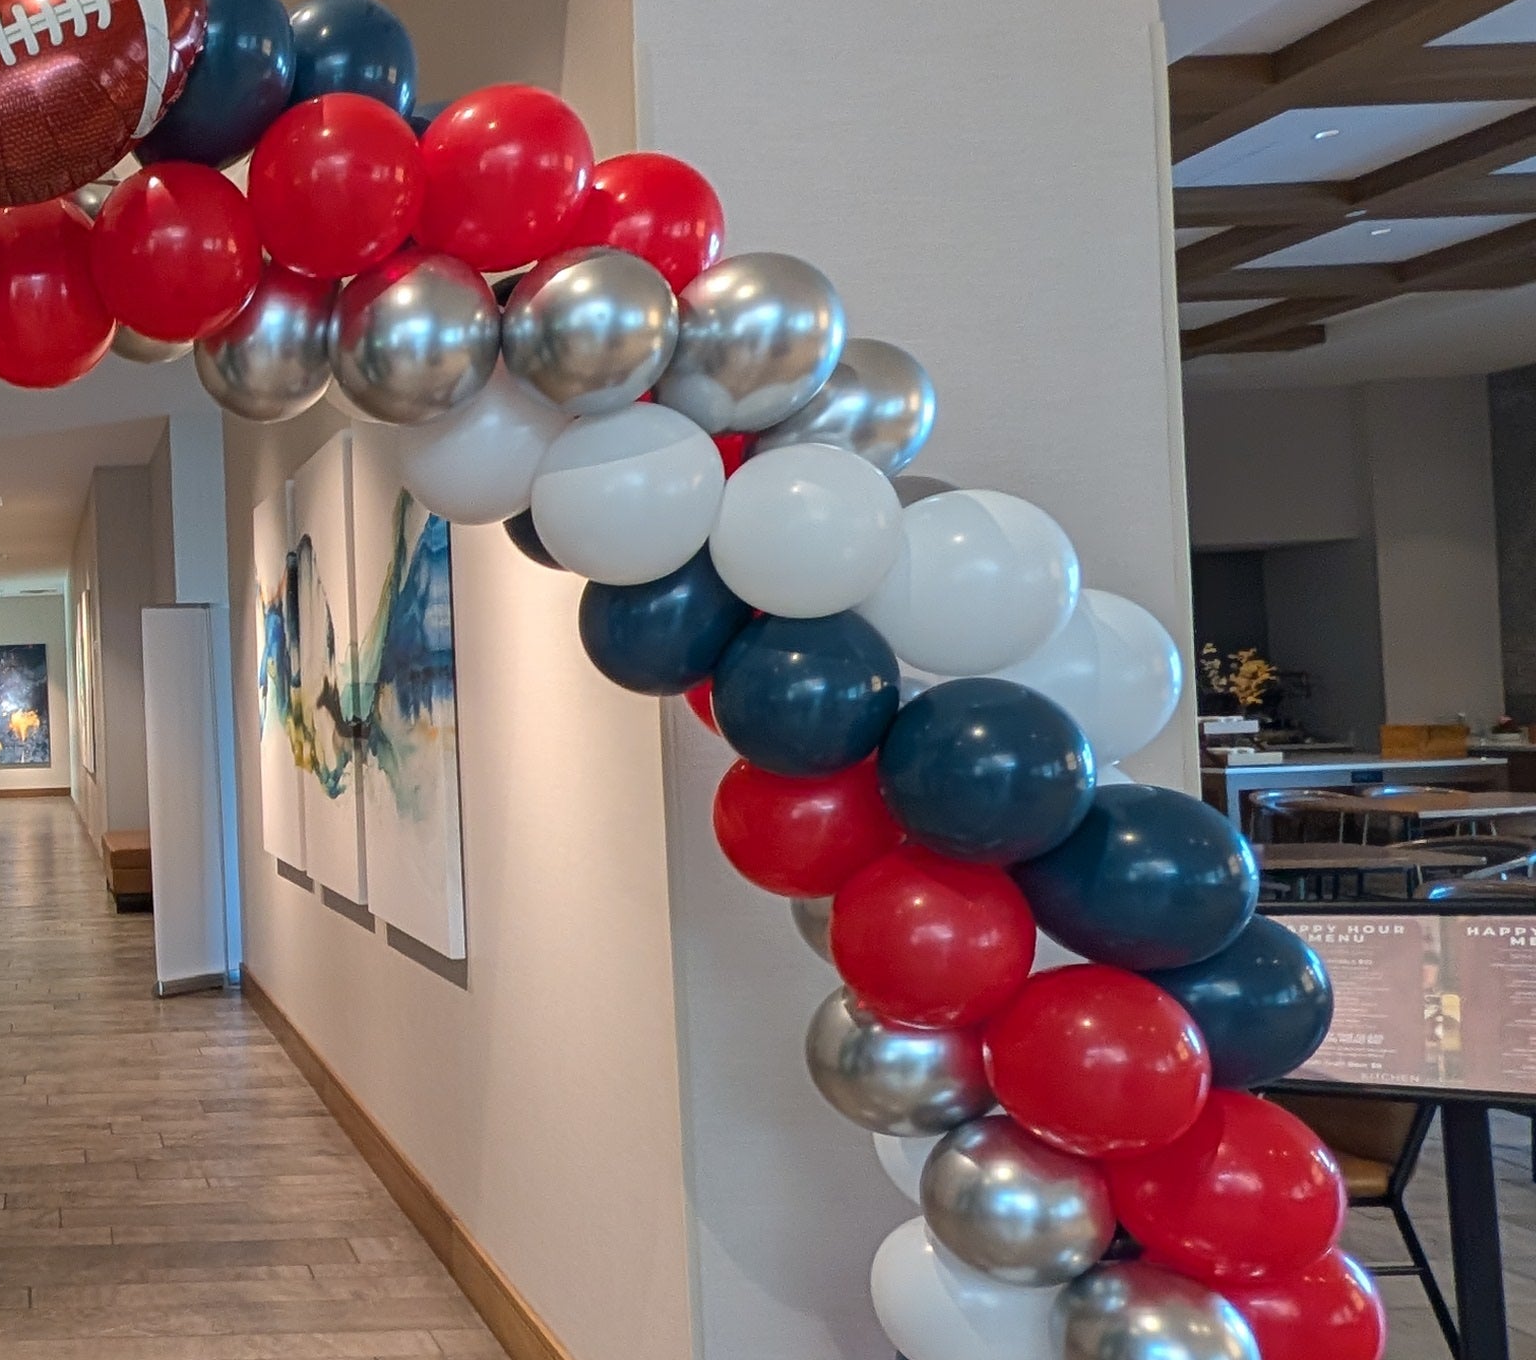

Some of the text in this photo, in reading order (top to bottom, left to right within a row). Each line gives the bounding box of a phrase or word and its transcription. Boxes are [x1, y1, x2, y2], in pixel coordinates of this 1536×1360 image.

[1287, 924, 1405, 935] APPY HOUR
[1308, 933, 1365, 943] MENU
[1509, 936, 1536, 946] ME
